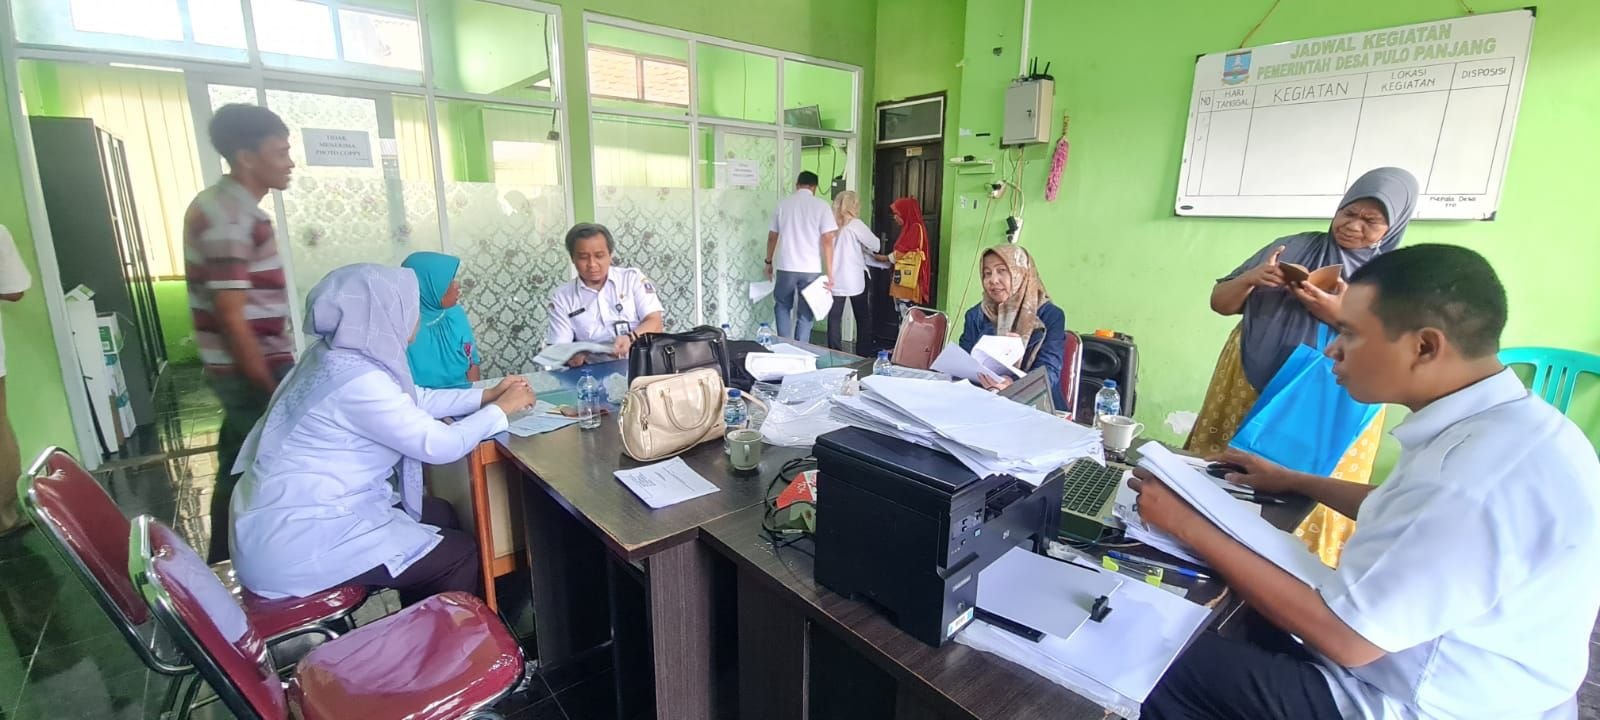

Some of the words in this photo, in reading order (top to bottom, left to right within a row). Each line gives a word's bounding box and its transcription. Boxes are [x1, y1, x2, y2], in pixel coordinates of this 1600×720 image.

[1290, 37, 1356, 59] JADWAL
[1362, 23, 1452, 50] KEGIATAN
[1257, 57, 1332, 80] PEMERINTAH
[1336, 53, 1369, 71] DESA
[1373, 47, 1409, 66] PULO
[1413, 37, 1497, 60] PANJANG
[1391, 68, 1427, 80] LOKASI
[1461, 67, 1507, 79] DISPOSISI
[1273, 81, 1349, 103] KEGIATAN
[1381, 78, 1436, 92] KEGIATAN
[1225, 89, 1244, 97] HARI
